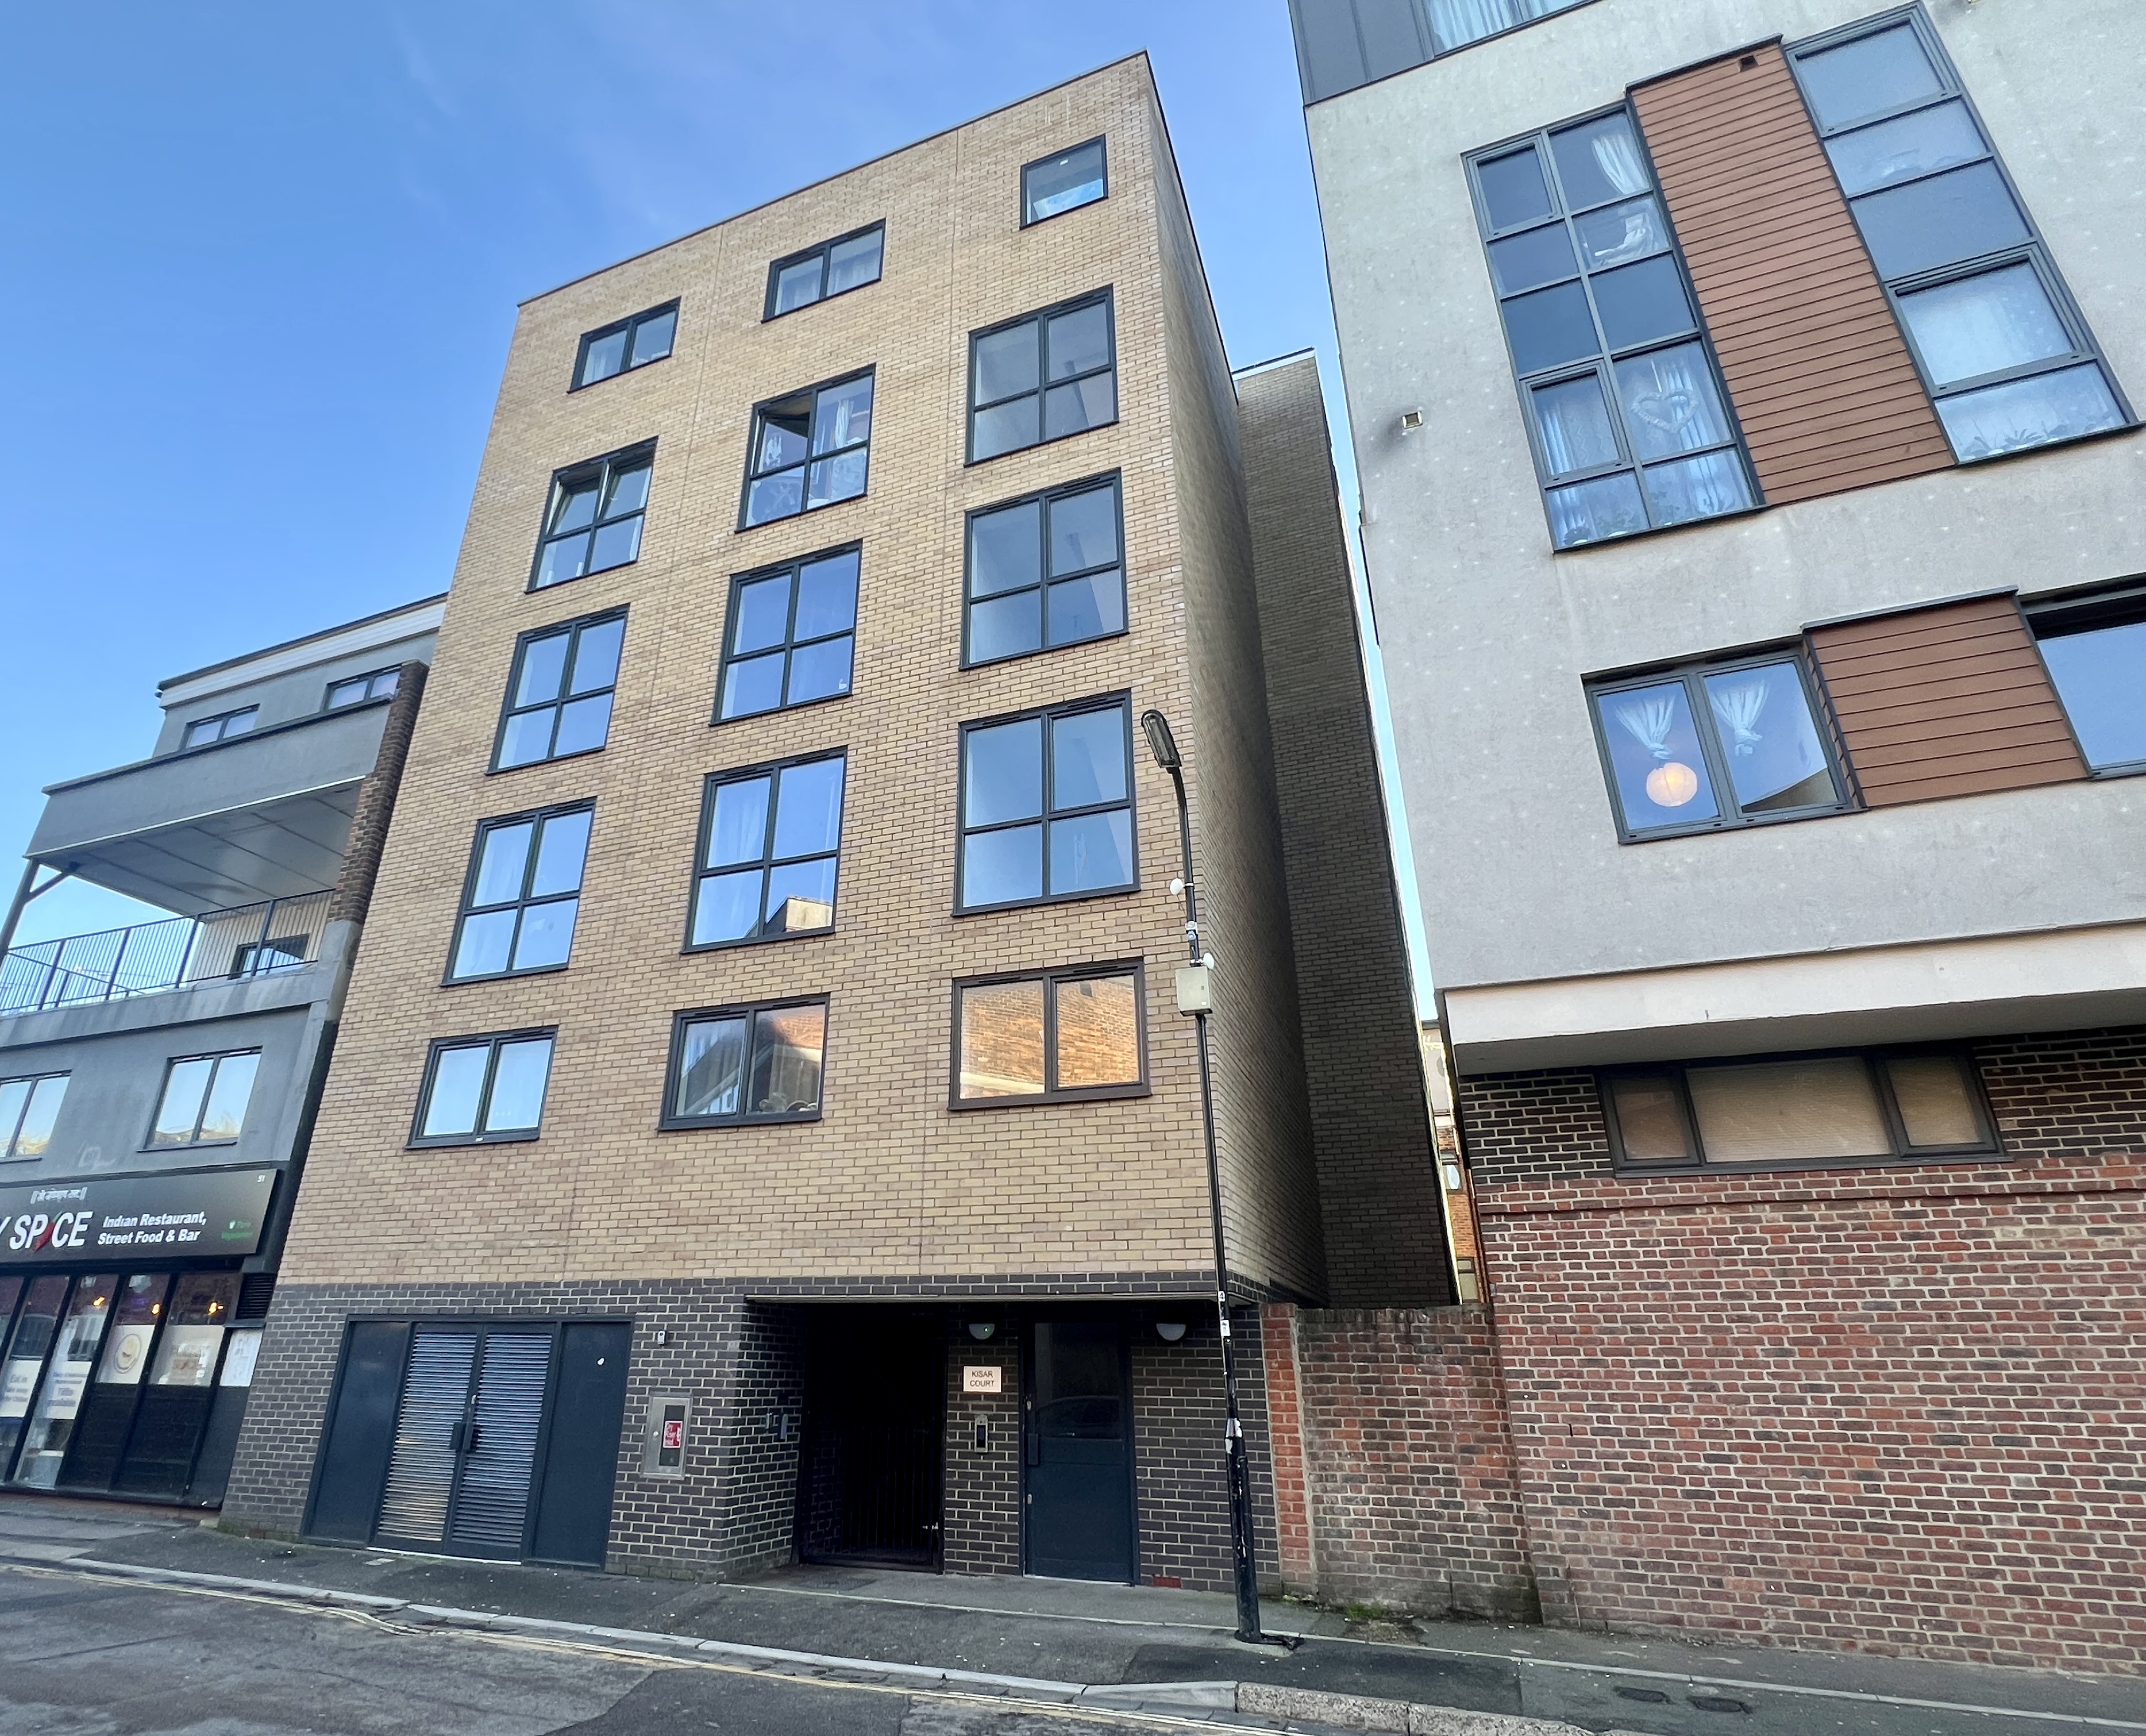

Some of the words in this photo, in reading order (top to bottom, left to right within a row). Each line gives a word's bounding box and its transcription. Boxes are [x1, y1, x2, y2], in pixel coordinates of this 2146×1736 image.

[103, 1215, 137, 1228] Indian
[140, 1211, 207, 1226] Restaurant,
[97, 1231, 133, 1246] Street
[134, 1230, 164, 1244] Food
[165, 1229, 176, 1242] &
[178, 1229, 201, 1242] Bar
